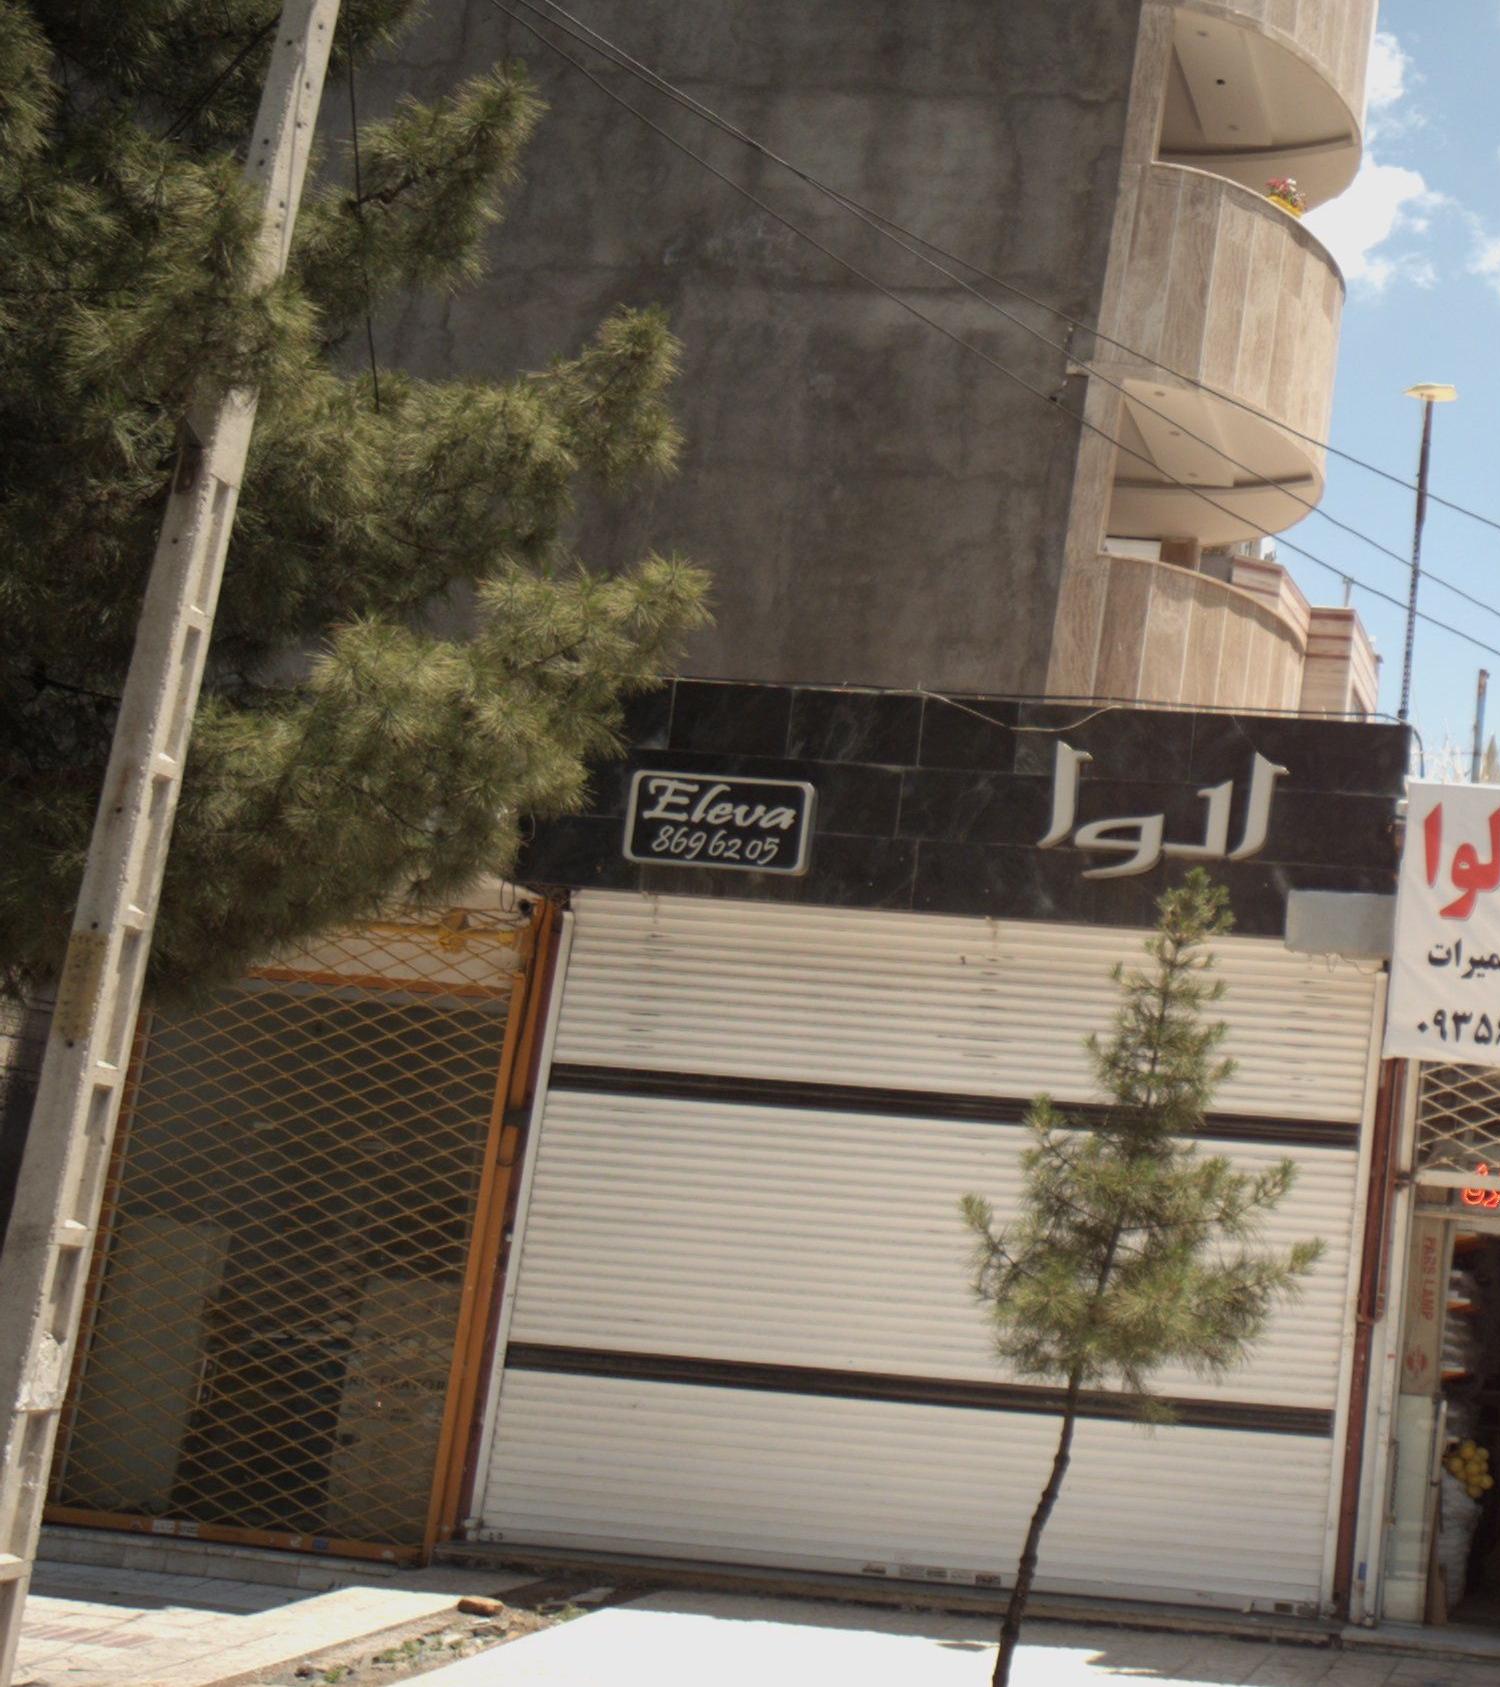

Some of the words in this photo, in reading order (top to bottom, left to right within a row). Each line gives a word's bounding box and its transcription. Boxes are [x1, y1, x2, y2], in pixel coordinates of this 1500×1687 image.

[643, 778, 797, 830] Eleva
[1037, 740, 1289, 879] الوا
[652, 825, 780, 865] 8696205
[1422, 1236, 1437, 1276] PARS
[1420, 1278, 1434, 1321] LAMP
